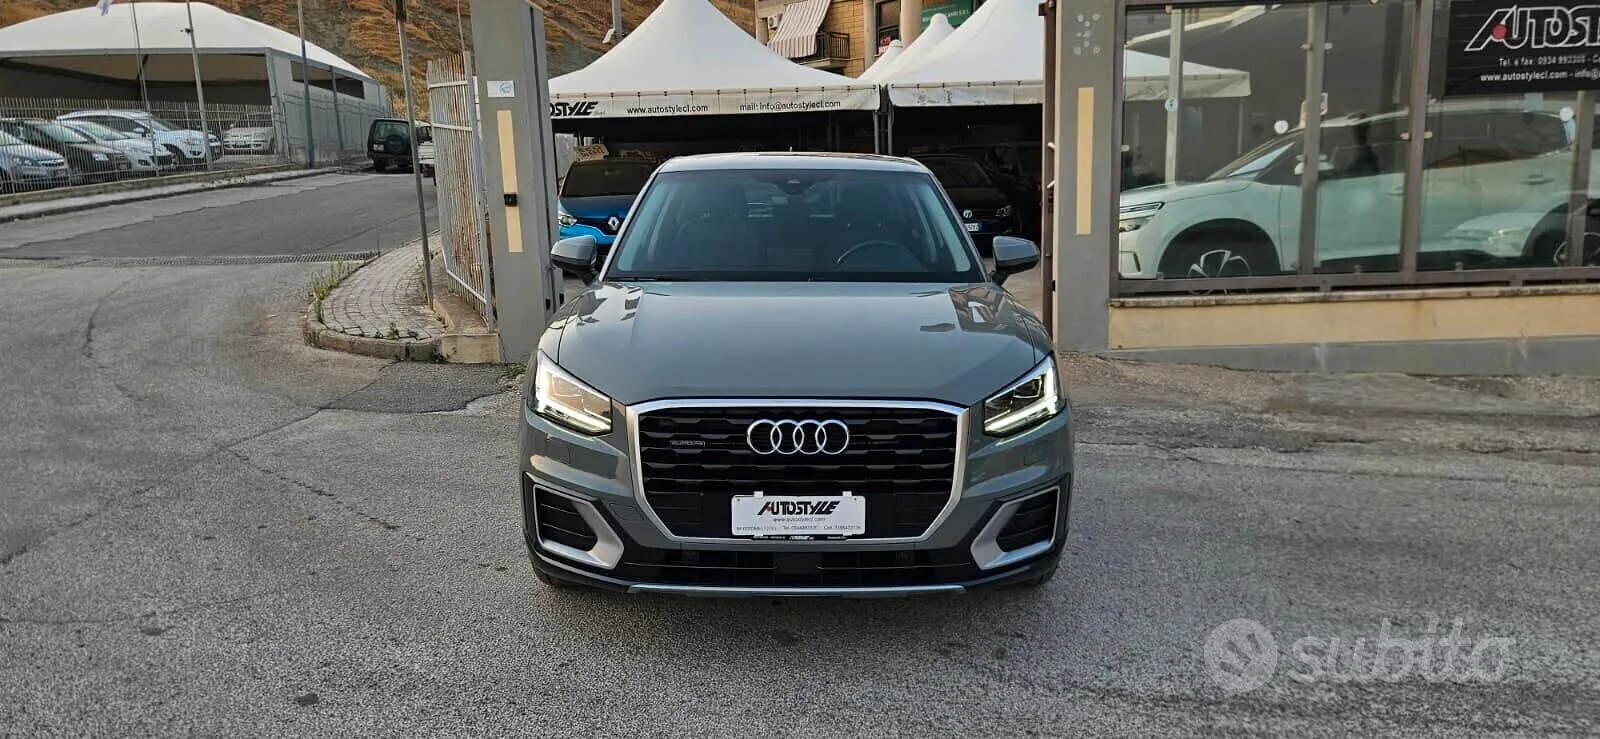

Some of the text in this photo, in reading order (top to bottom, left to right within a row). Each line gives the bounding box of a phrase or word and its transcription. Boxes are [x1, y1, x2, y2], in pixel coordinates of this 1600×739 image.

[1480, 68, 1568, 82] www.autostylecl.com
[626, 103, 709, 115] www.autostylecl.com
[757, 500, 841, 516] AUTOSTYLE
